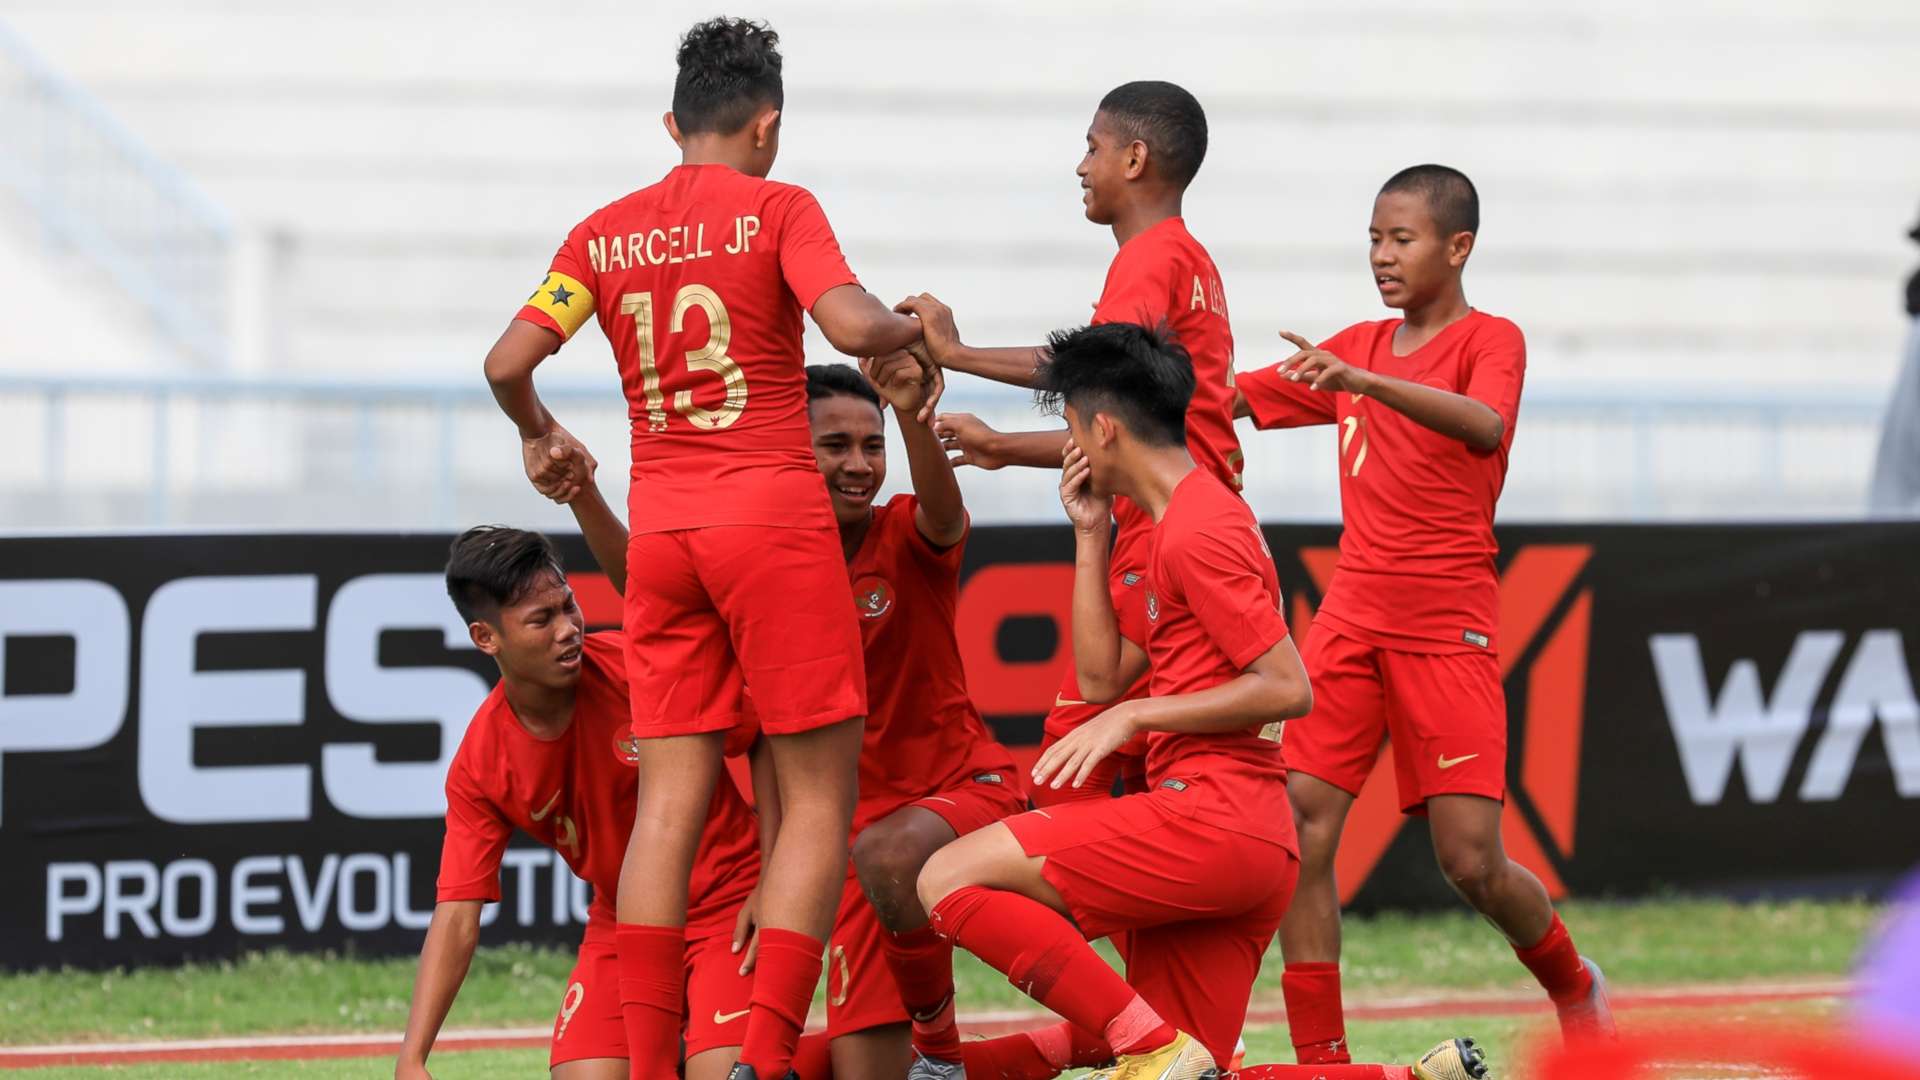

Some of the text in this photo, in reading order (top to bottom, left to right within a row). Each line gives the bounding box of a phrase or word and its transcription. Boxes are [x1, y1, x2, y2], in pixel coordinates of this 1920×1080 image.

[724, 215, 761, 256] JP
[1190, 274, 1206, 312] A
[620, 283, 748, 432] 13
[0, 571, 491, 828] PES
[46, 848, 592, 941] PRO EVOLTI
[557, 982, 584, 1040] 9
